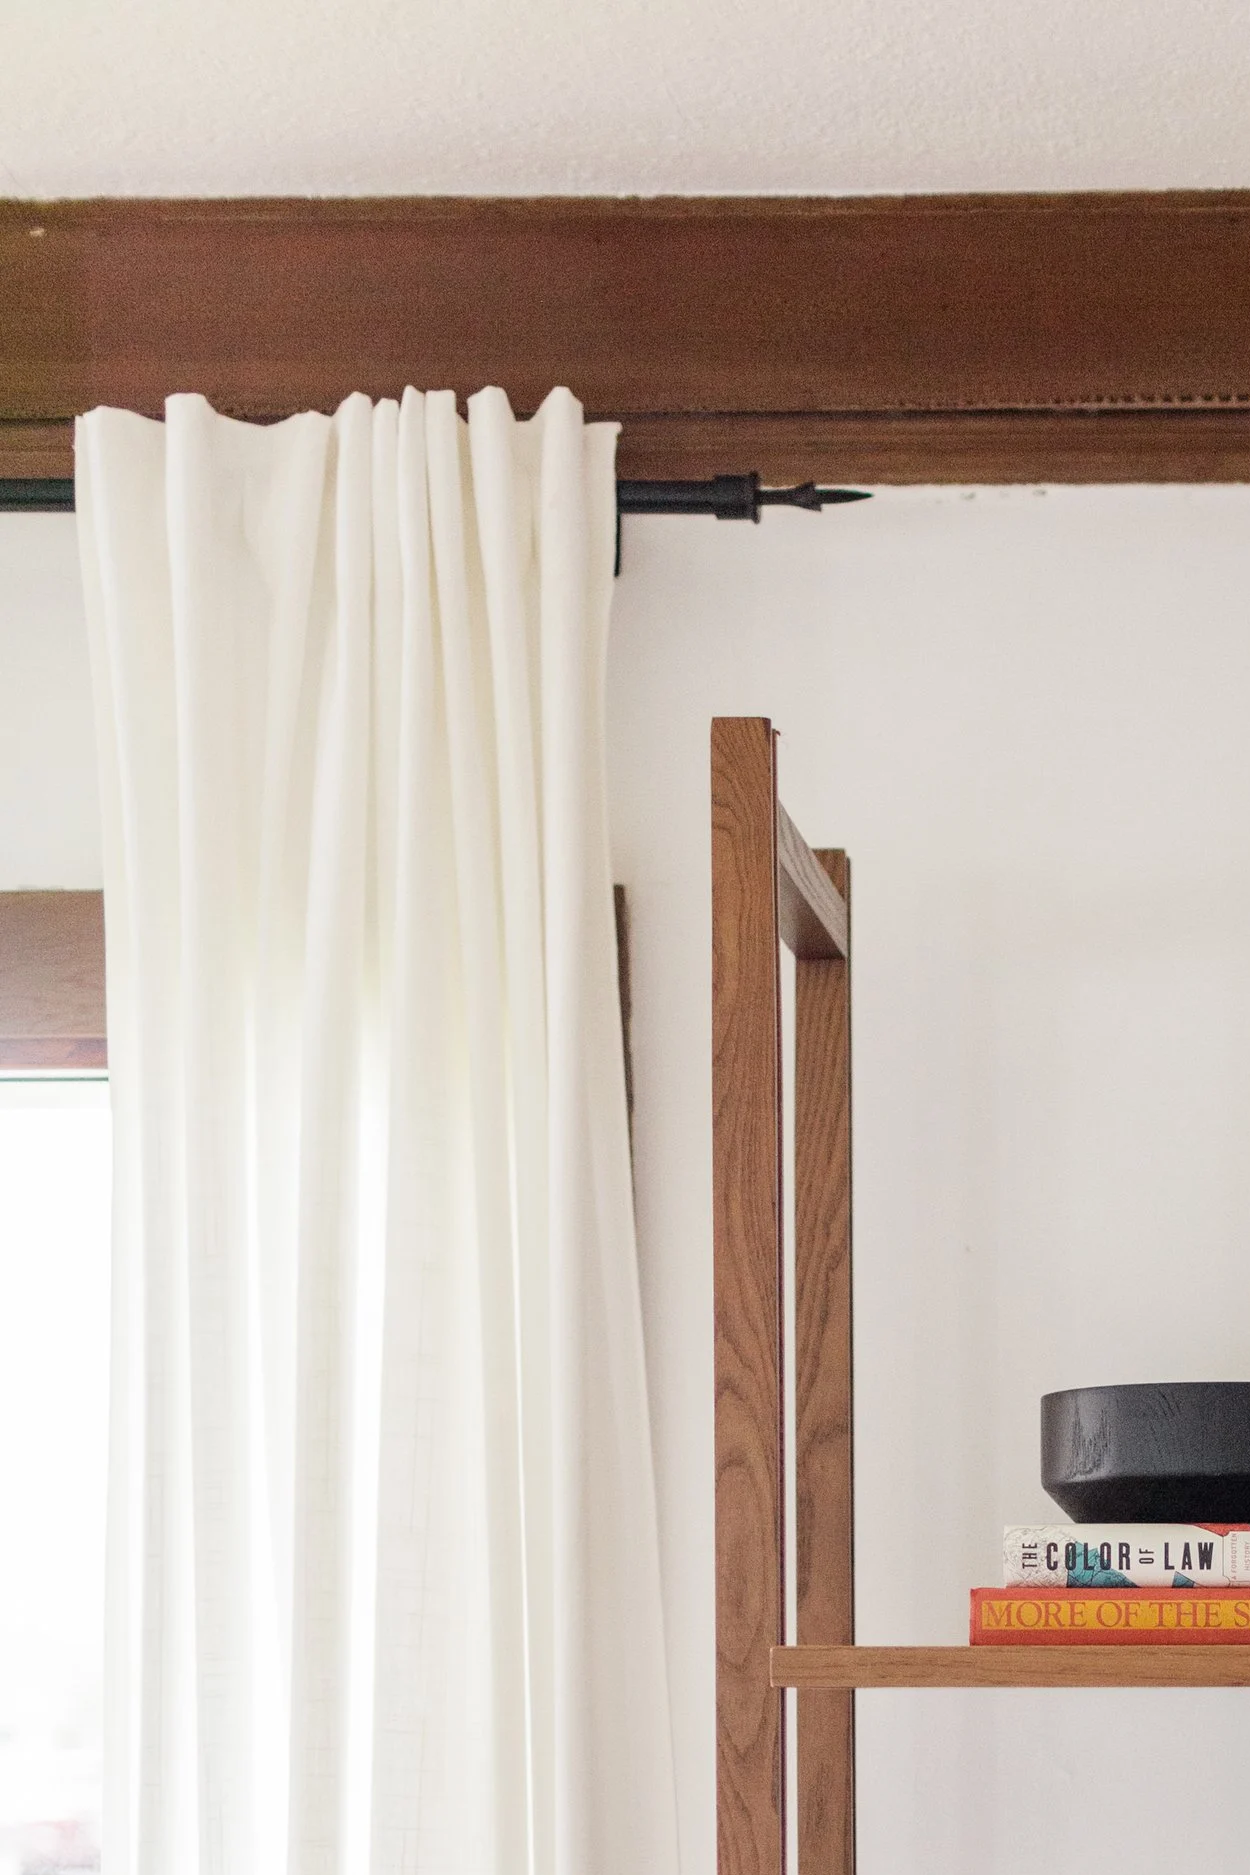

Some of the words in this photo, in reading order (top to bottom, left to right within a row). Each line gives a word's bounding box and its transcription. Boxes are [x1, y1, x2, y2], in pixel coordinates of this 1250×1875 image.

[1022, 1543, 1037, 1569] THE
[1046, 1542, 1131, 1571] COLOR
[1139, 1549, 1154, 1564] OF
[1164, 1542, 1214, 1571] LAW
[985, 1601, 1087, 1627] MORE
[1096, 1601, 1141, 1628] OF
[1150, 1601, 1223, 1627] THE
